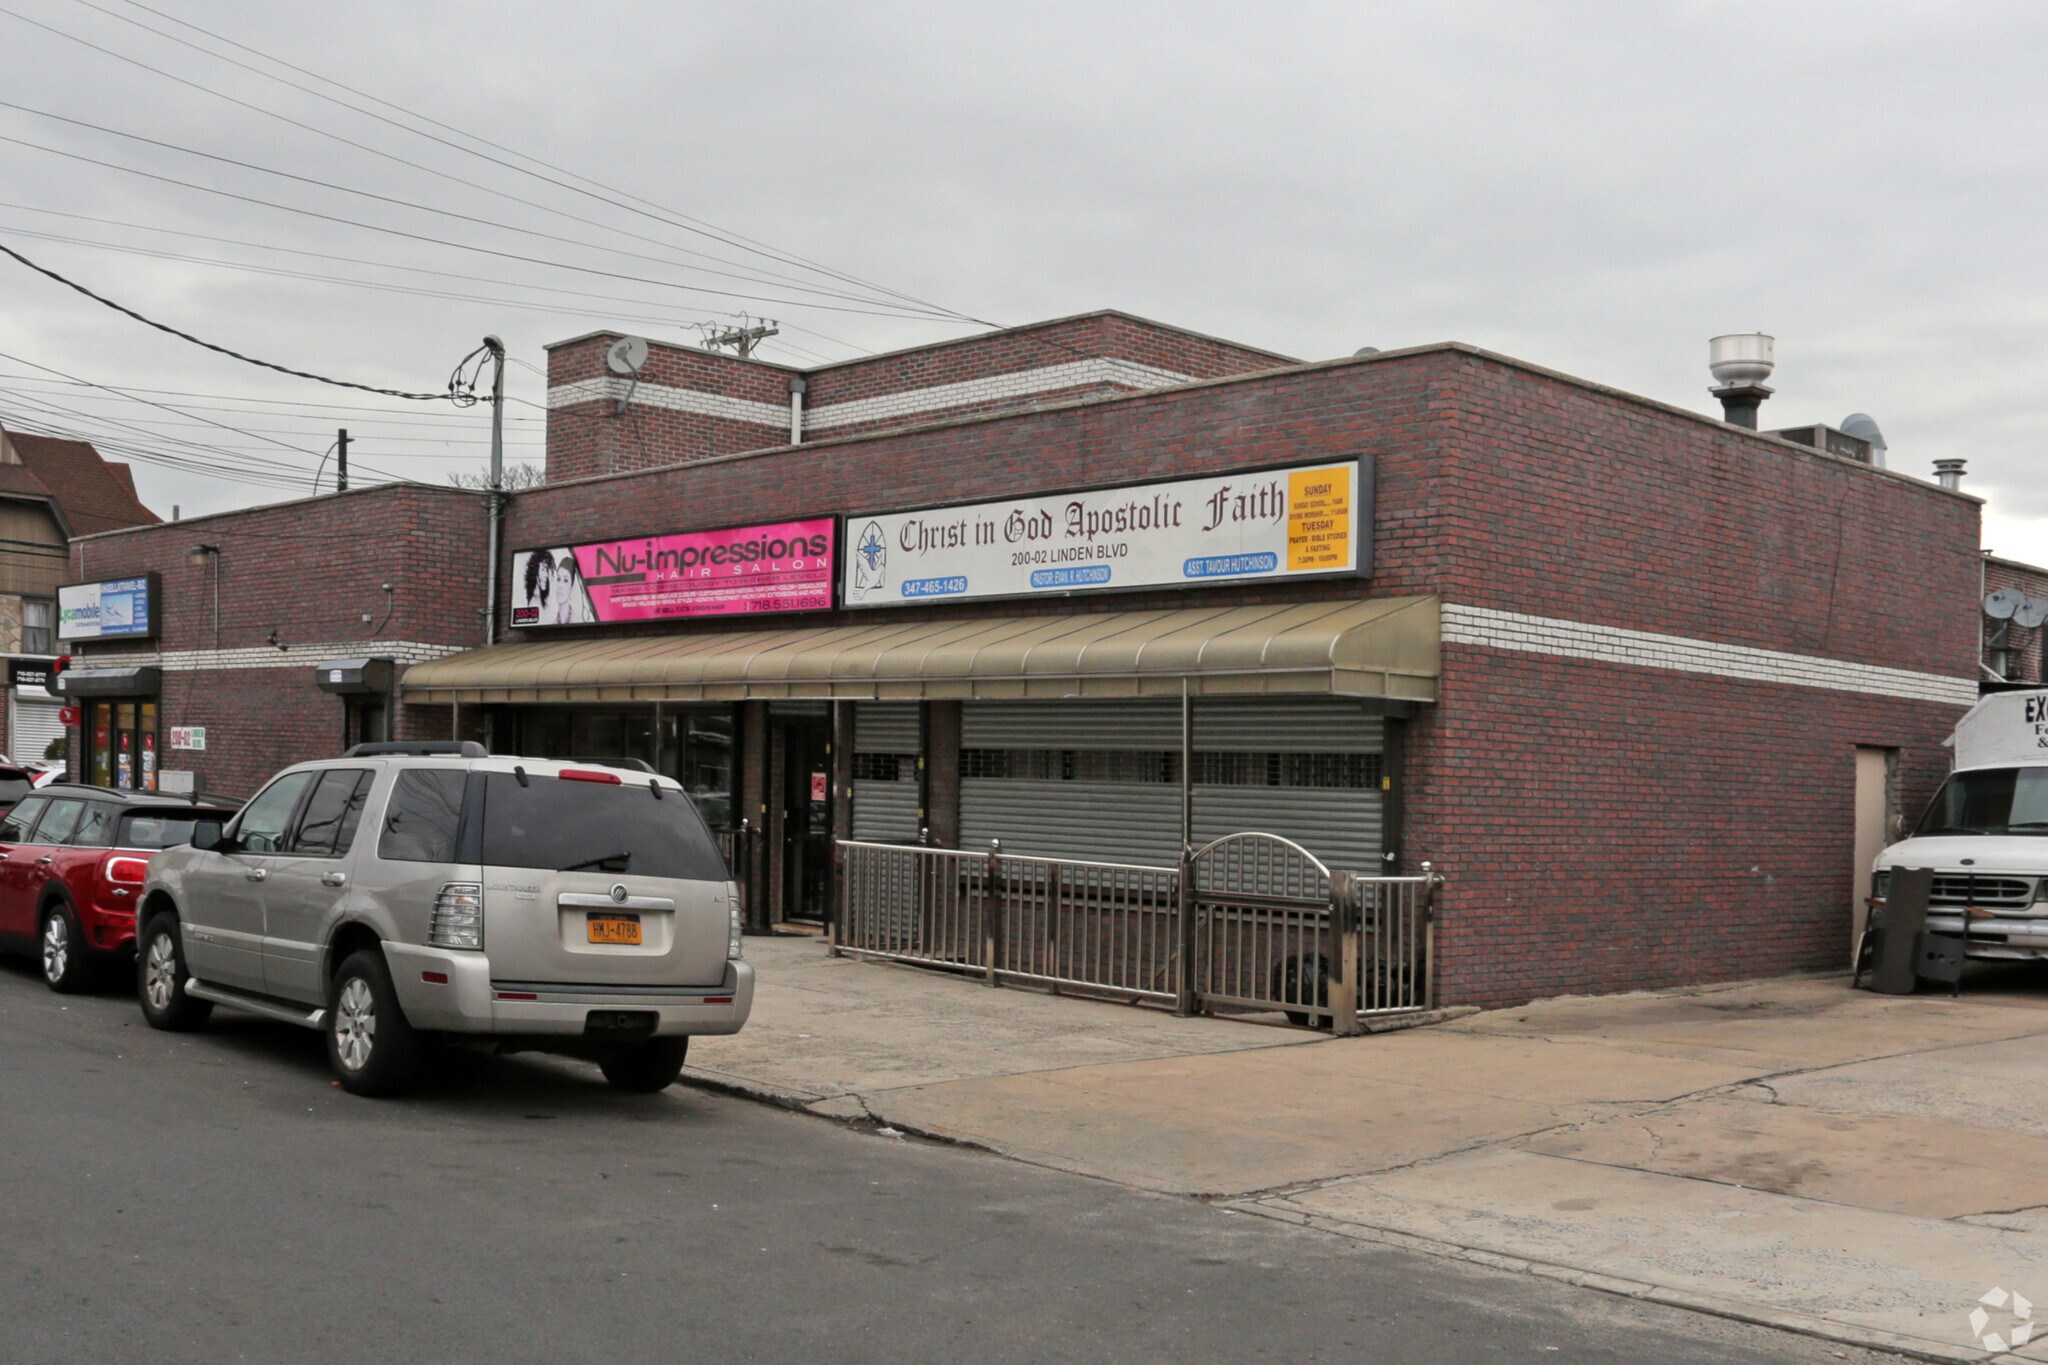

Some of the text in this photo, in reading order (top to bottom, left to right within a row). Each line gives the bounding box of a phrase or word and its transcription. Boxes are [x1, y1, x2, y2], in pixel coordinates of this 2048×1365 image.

[1304, 483, 1332, 496] SUNDAY
[899, 480, 1284, 557] Christ in God Apostolic Faith
[1302, 519, 1335, 531] TUESDAY
[1289, 535, 1308, 544] PRAYER
[596, 534, 828, 576] Nu-impressions
[1012, 543, 1128, 566] 200-02 LINDEN BLVD
[1231, 554, 1274, 571] HUTCHINSON
[657, 558, 827, 580] HAIR SALON
[783, 571, 827, 580] LEVELS
[904, 578, 965, 595] 347-465-1426
[2026, 695, 2048, 722] EX
